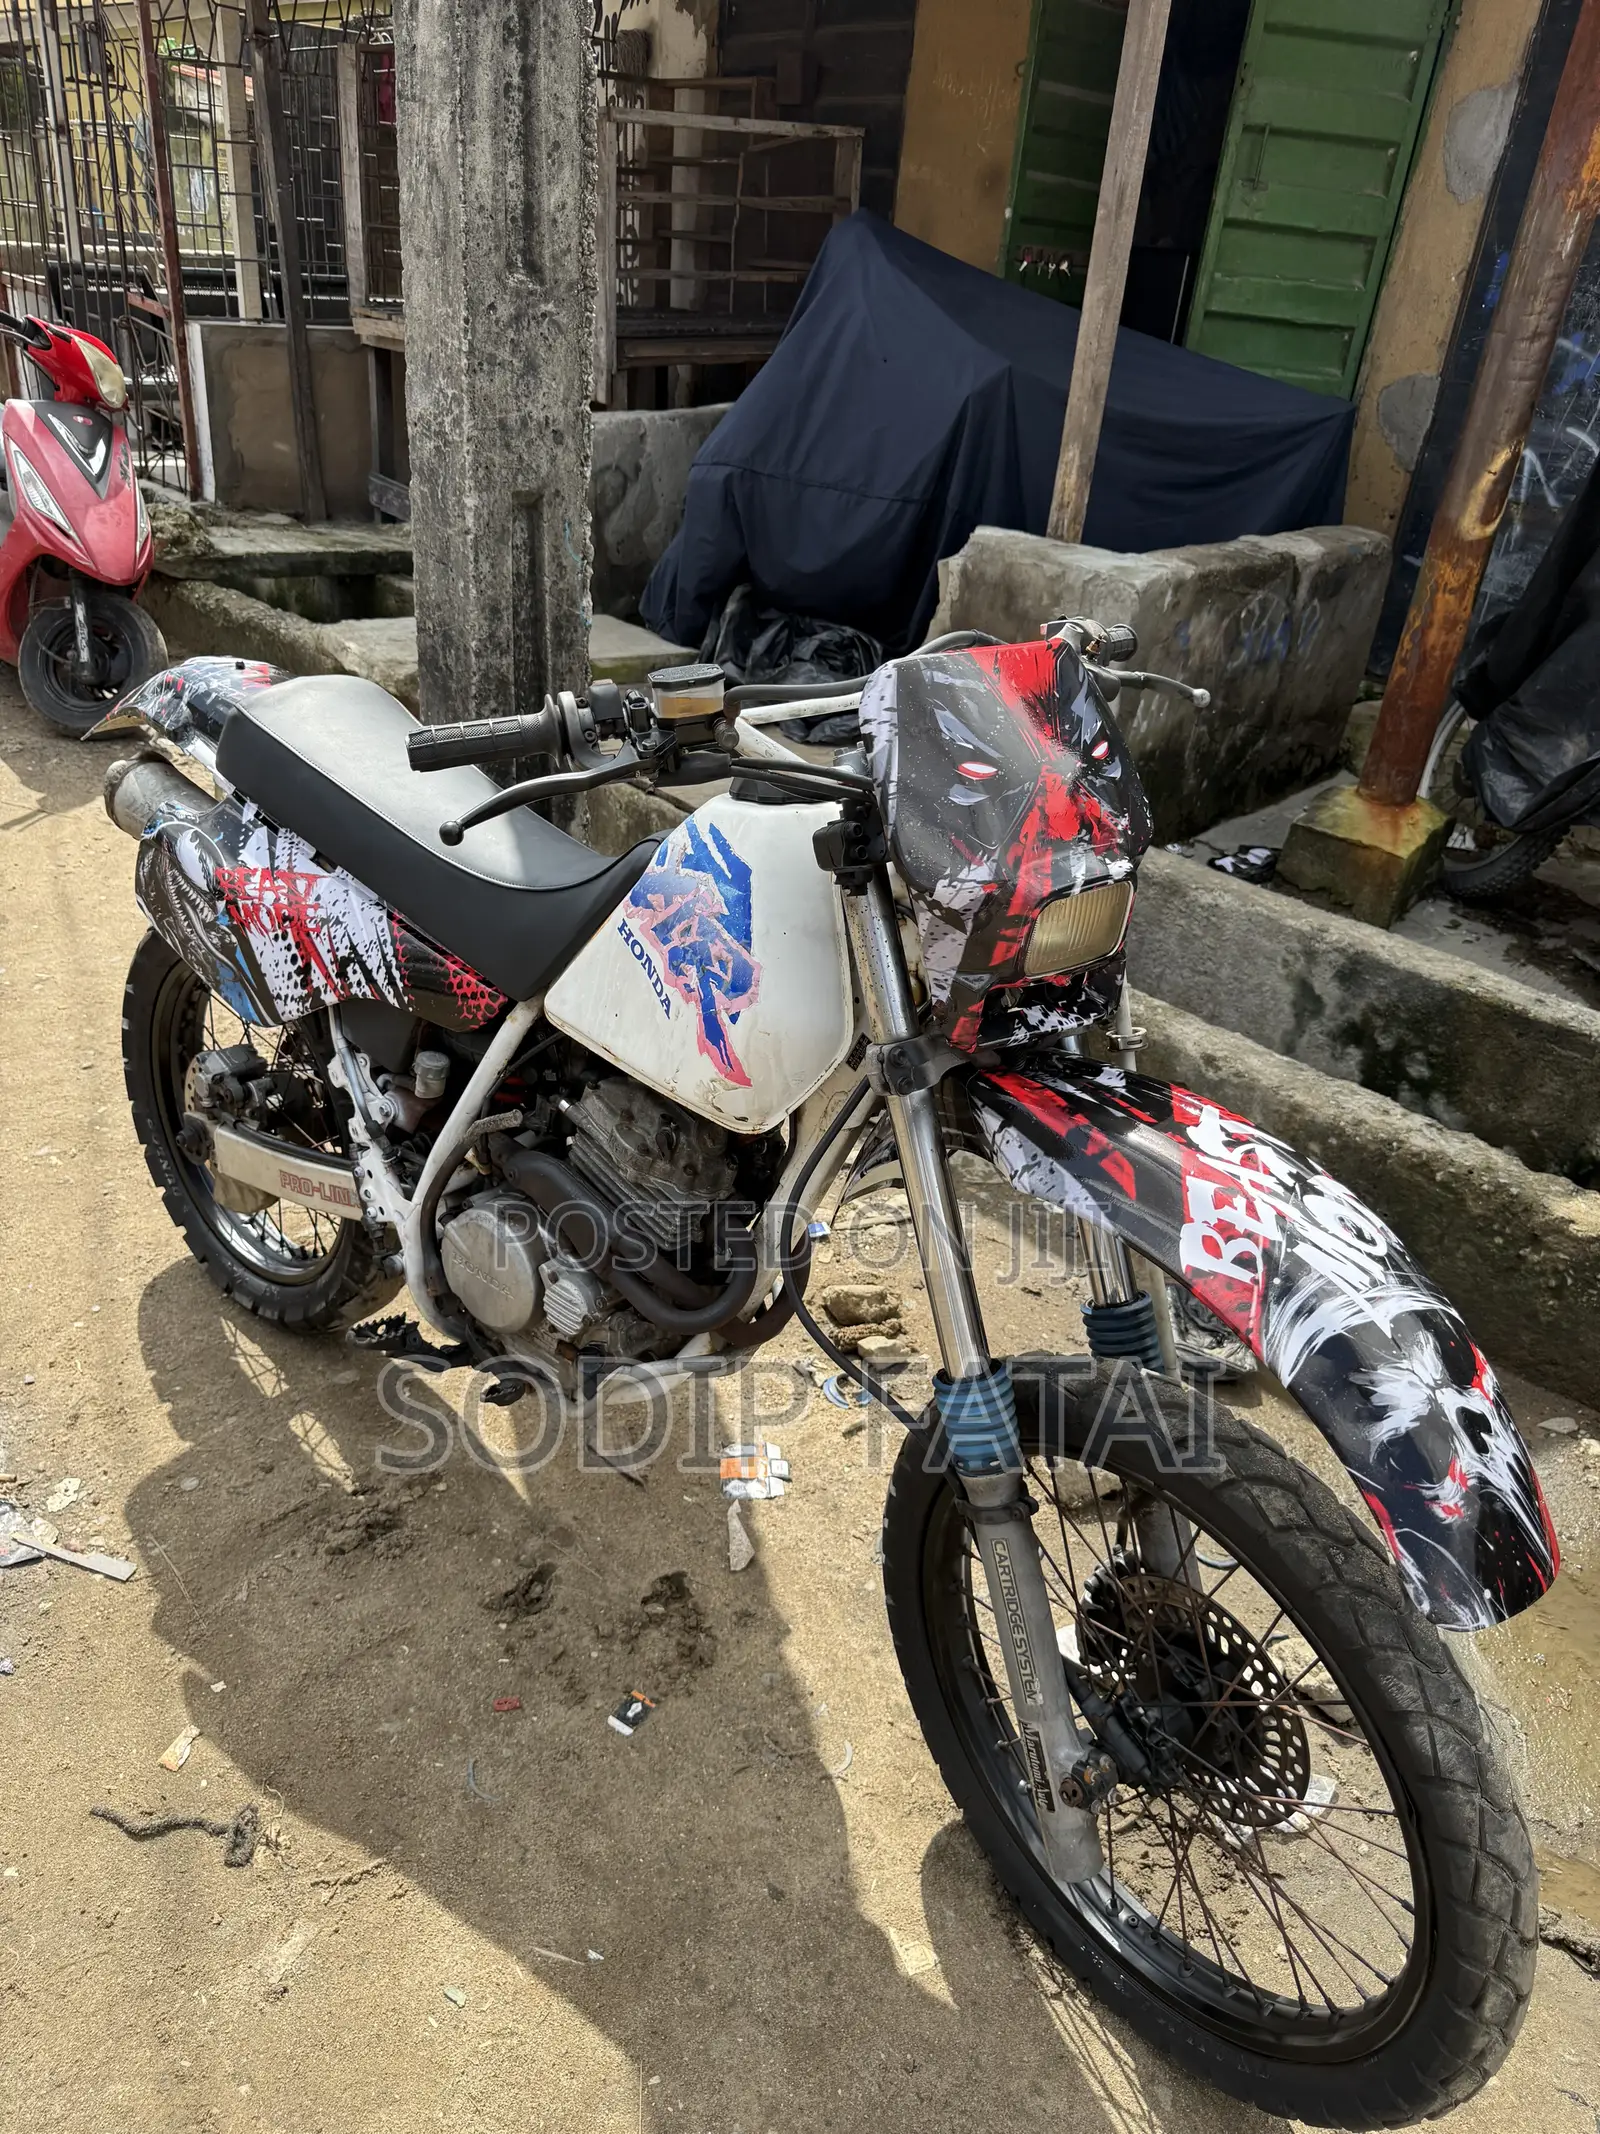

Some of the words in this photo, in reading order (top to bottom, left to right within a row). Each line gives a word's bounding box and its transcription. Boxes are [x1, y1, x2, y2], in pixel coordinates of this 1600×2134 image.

[617, 918, 672, 1020] HONDA
[452, 1252, 516, 1301] HONDA
[993, 1540, 1023, 1636] CARTRIDGE
